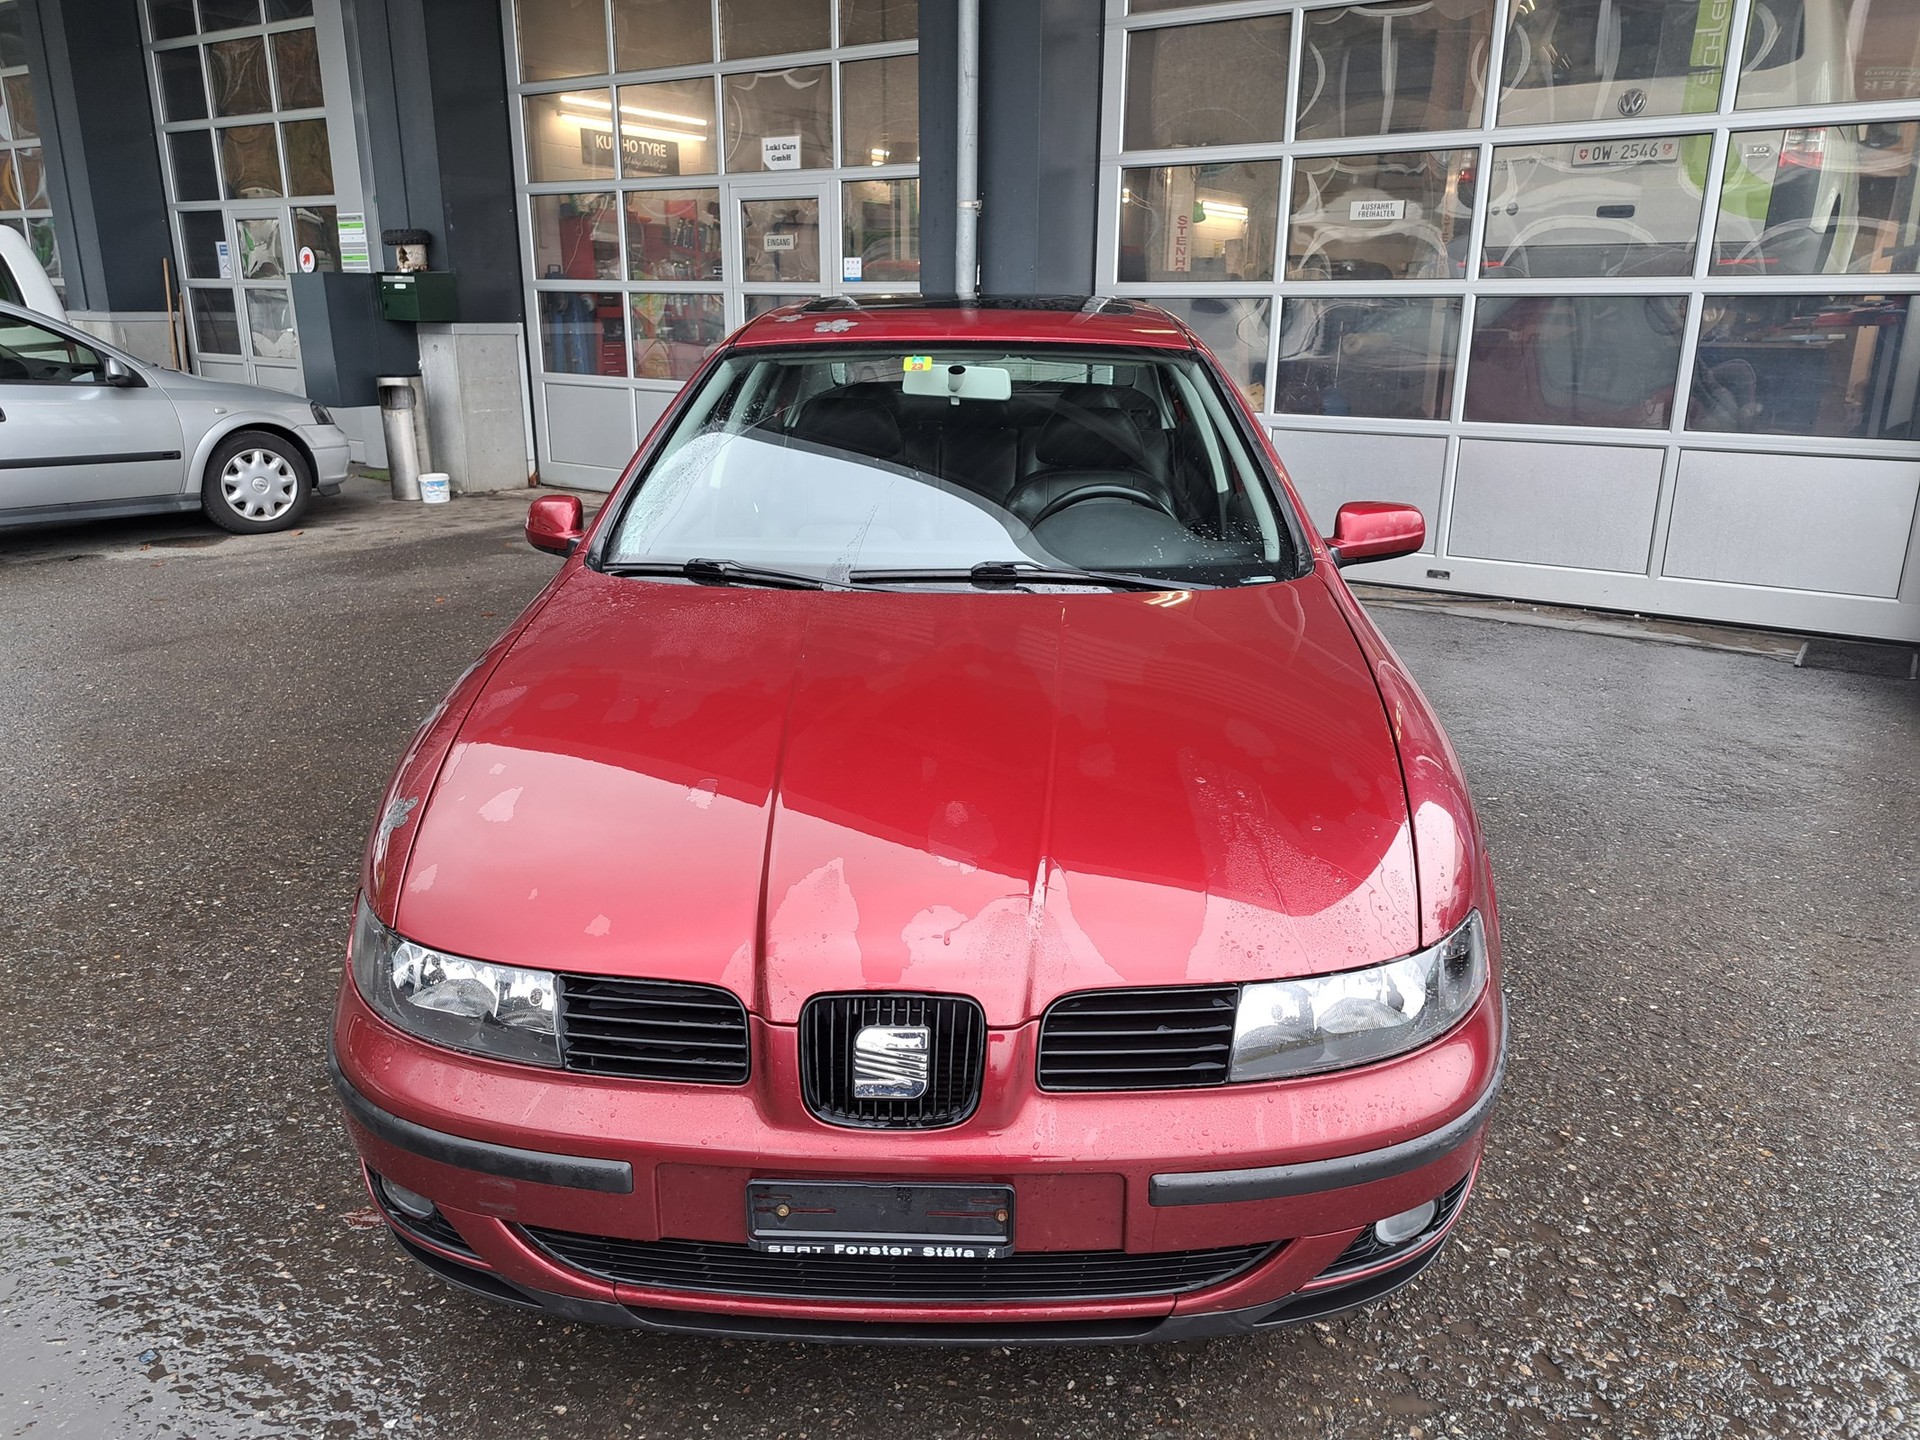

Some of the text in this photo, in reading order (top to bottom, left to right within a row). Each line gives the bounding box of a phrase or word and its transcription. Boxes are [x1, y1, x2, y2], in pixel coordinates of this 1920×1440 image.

[596, 135, 667, 157] KUHO TYRE
[1361, 202, 1394, 211] AUSFAHRT
[1357, 208, 1396, 218] FREIHALTEN
[766, 237, 791, 247] EINGANG
[768, 1244, 975, 1258] SEAT Forster Stäfa
